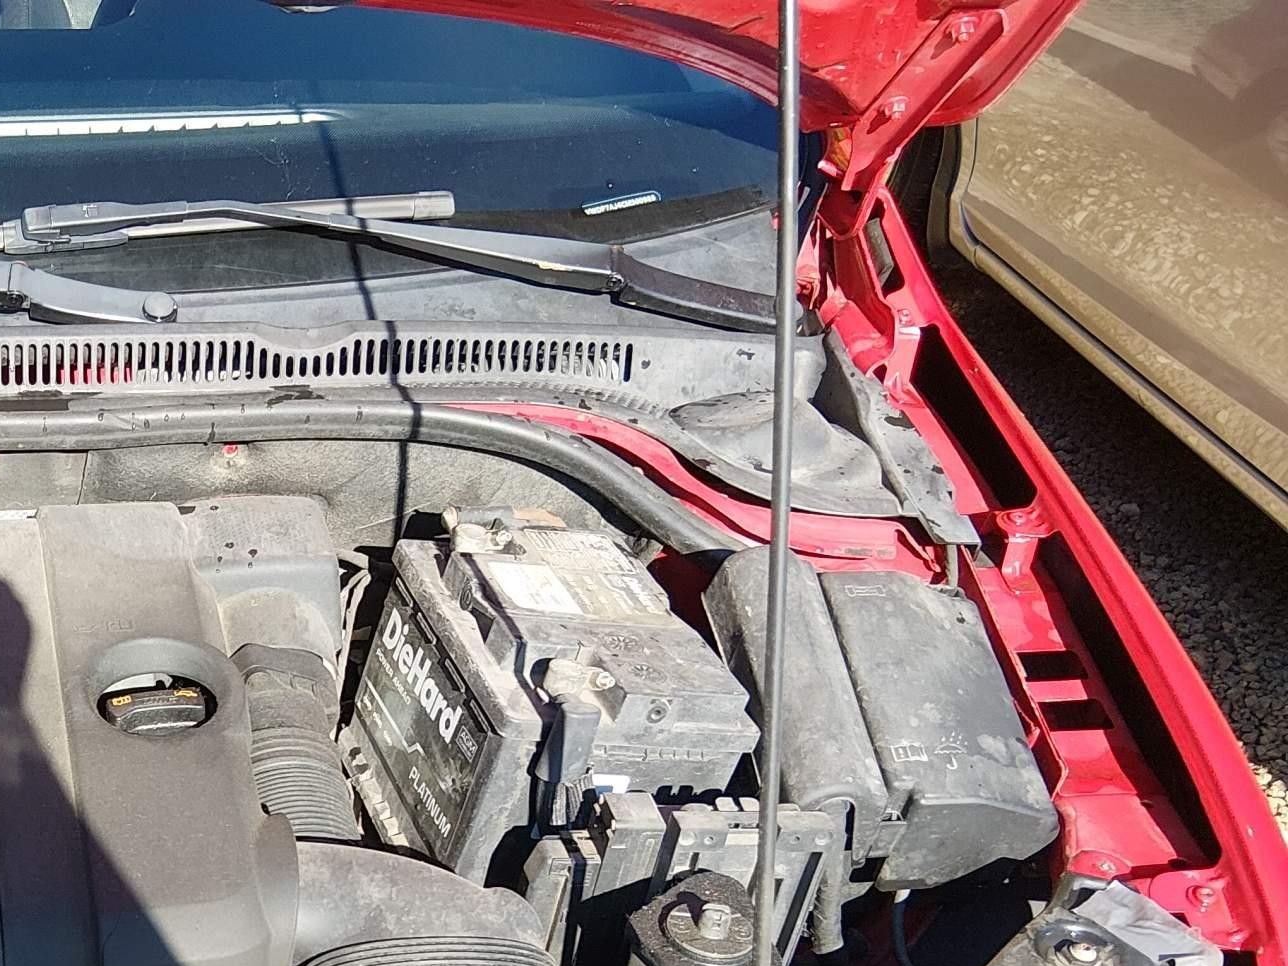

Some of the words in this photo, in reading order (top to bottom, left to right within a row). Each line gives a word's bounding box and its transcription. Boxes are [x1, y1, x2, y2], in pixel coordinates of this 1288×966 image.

[382, 607, 463, 744] DieHard
[460, 731, 478, 755] AGM
[408, 766, 452, 838] PLATINUM
